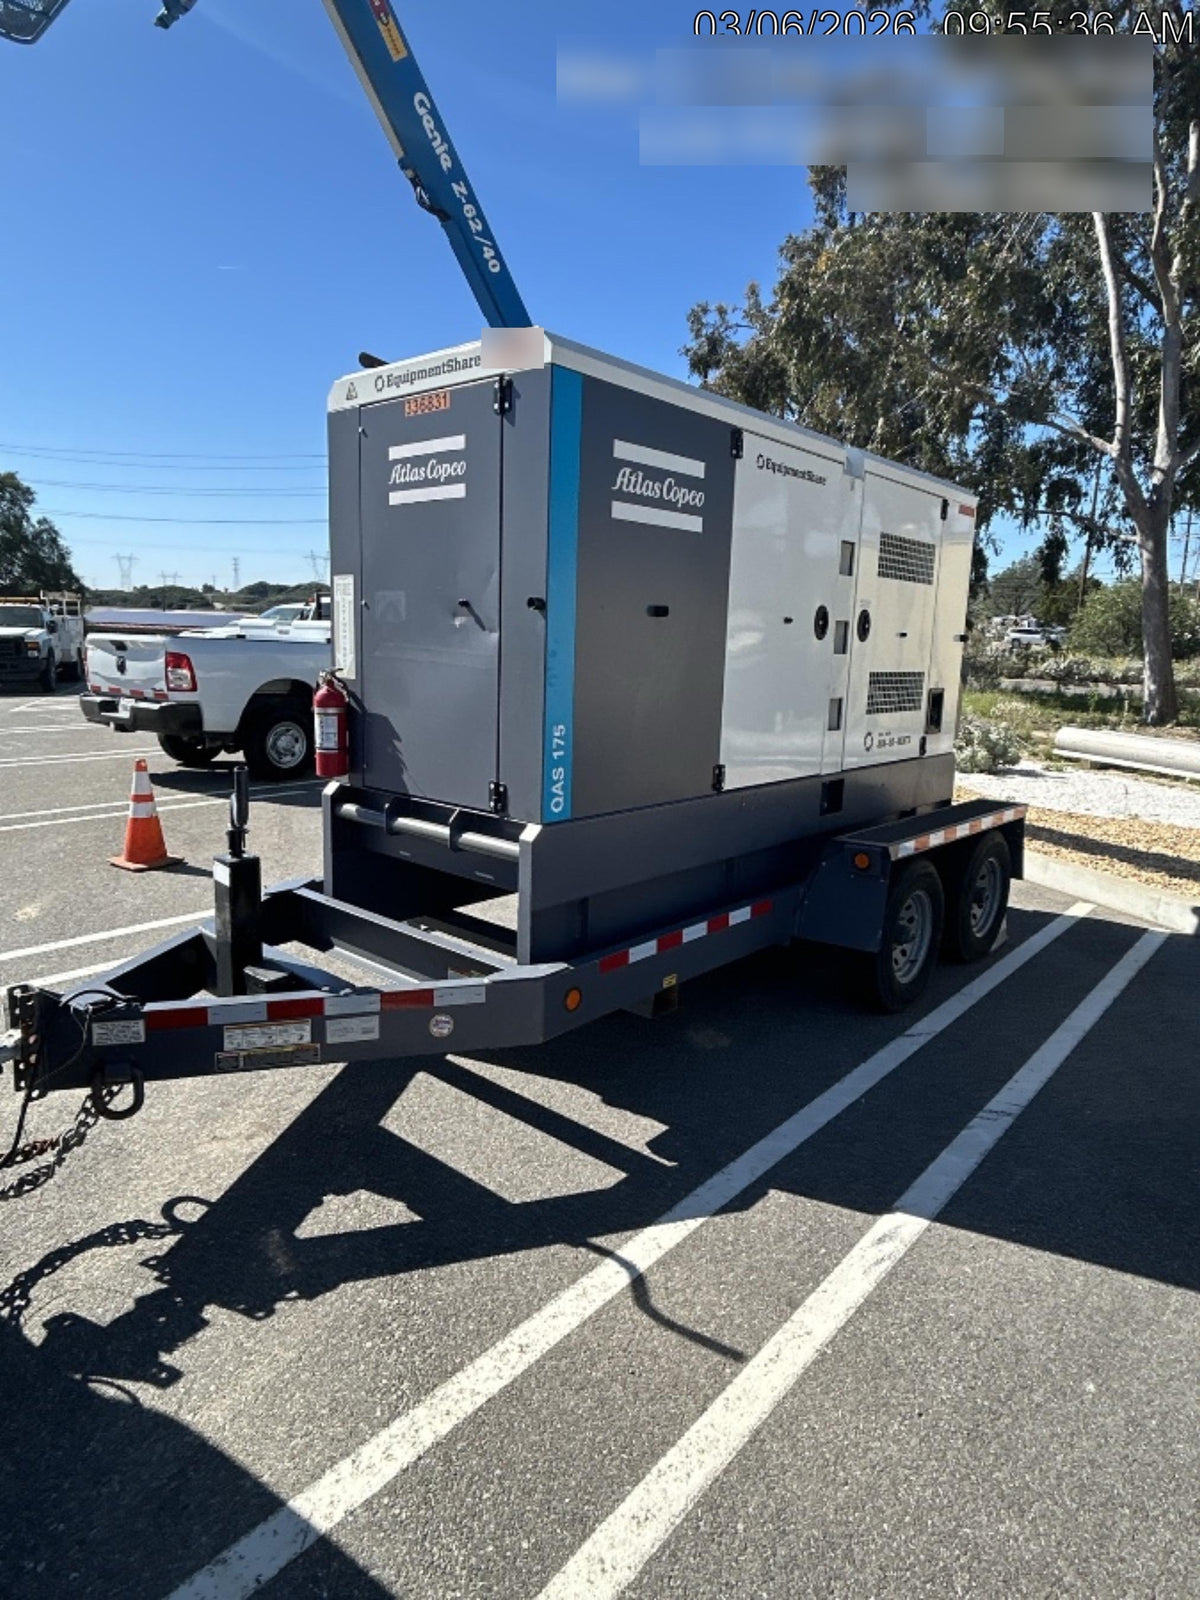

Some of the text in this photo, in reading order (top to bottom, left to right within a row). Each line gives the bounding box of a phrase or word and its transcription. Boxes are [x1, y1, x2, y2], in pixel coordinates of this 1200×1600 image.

[413, 91, 501, 273] Genie Z-62/40
[386, 354, 482, 389] EquipmentShare
[388, 458, 467, 485] Atlas Copco
[611, 466, 705, 508] Atlas Copco
[550, 723, 566, 813] QAS 175
